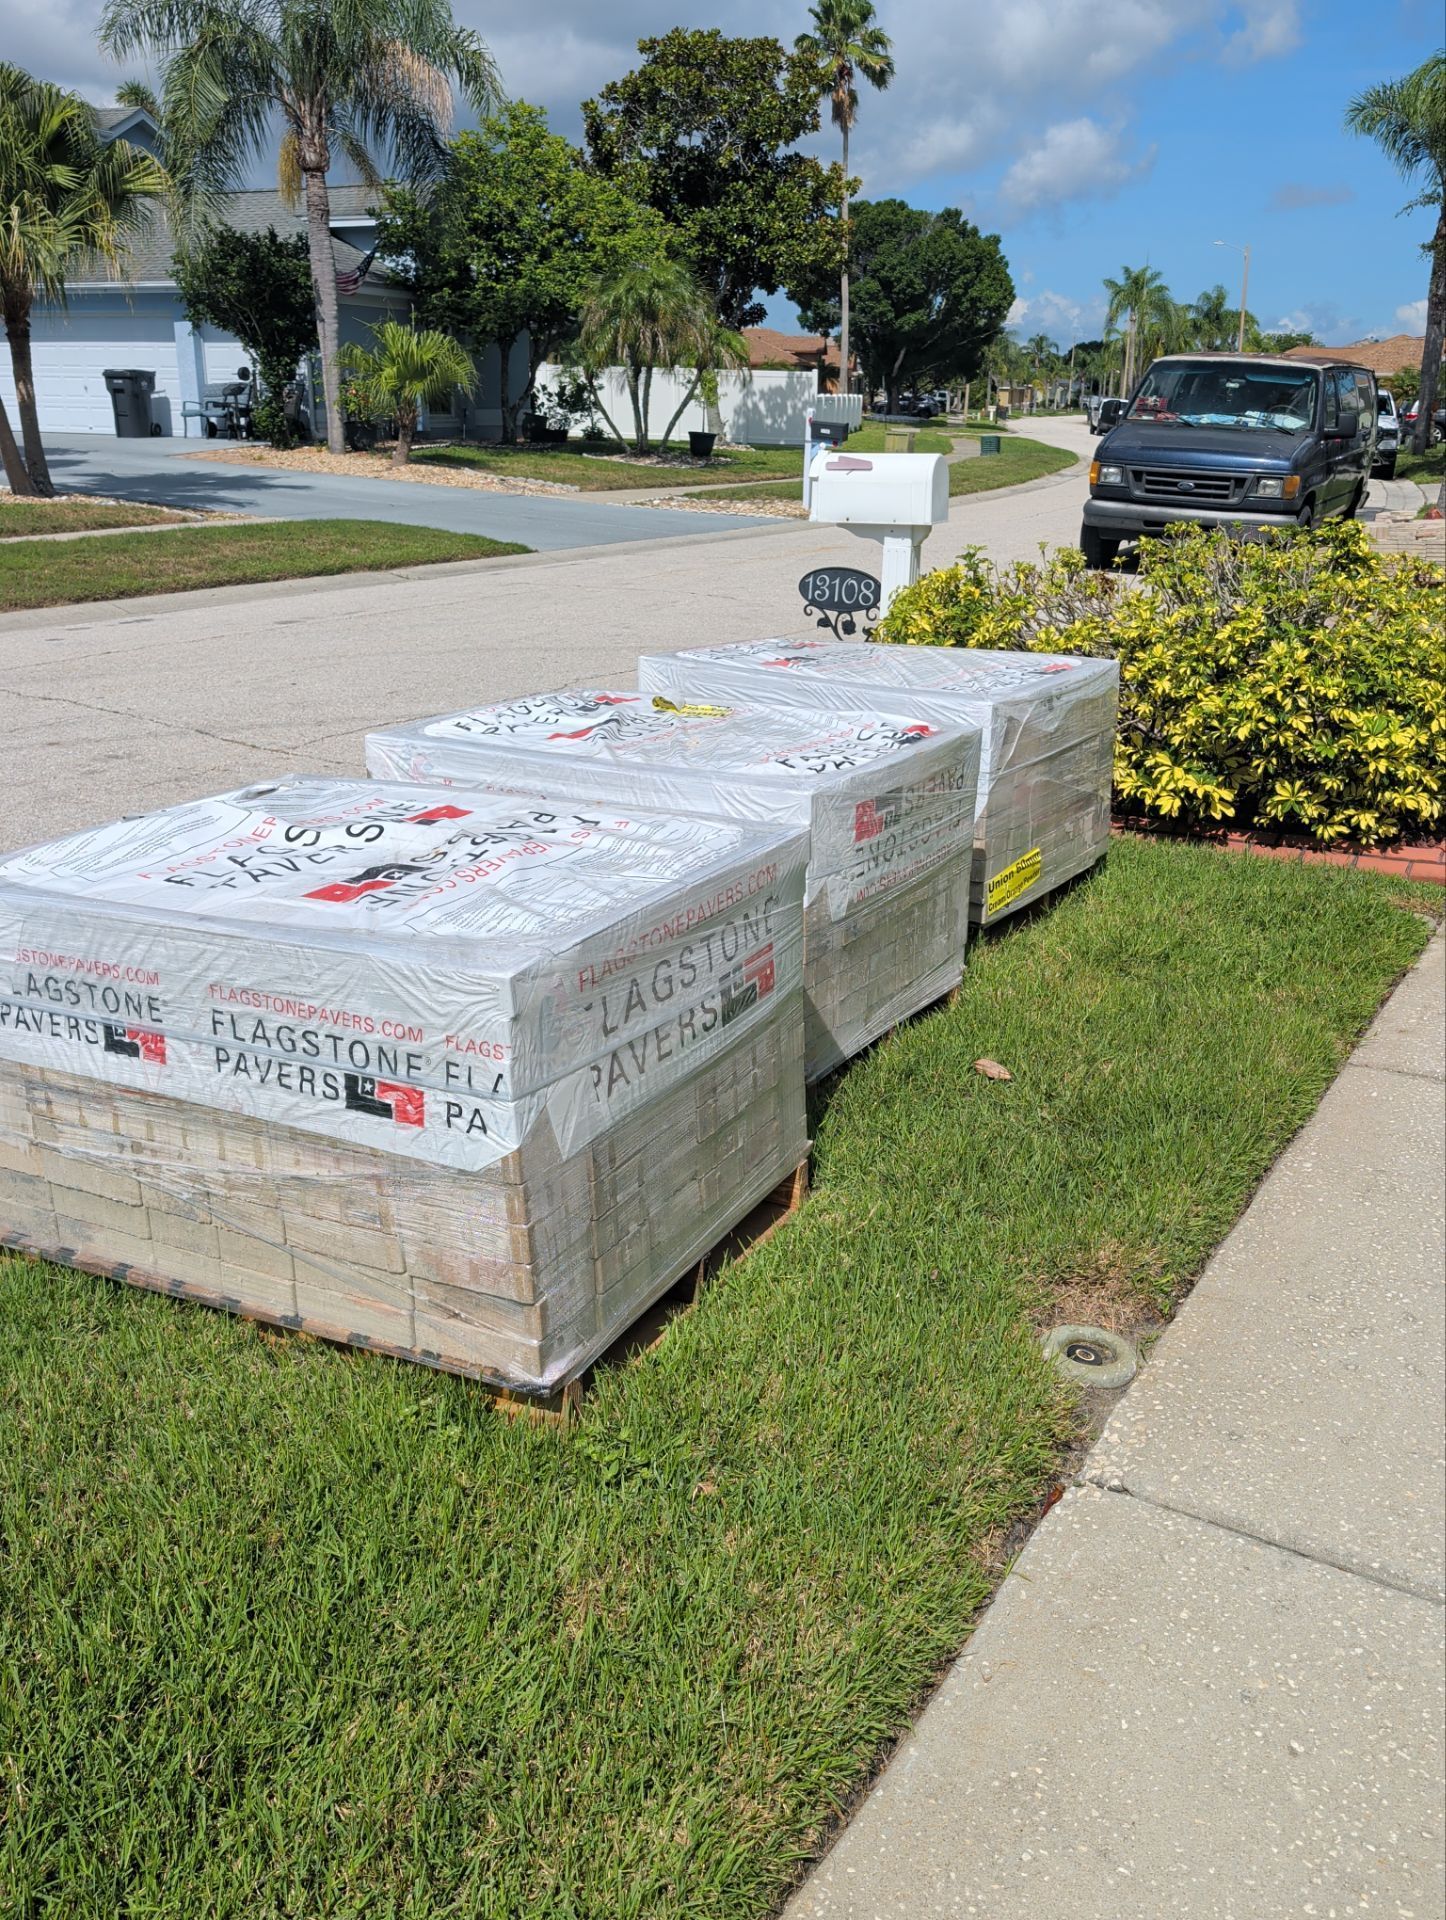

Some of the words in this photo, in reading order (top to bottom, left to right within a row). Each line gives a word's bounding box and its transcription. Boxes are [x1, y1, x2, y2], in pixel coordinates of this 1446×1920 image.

[804, 574, 876, 606] 13108
[137, 798, 390, 879] FAGSTONEPERS.COM
[163, 803, 428, 887] FLAGSNE
[988, 871, 1014, 894] Union
[579, 863, 778, 993] FLAGSTONEPAVERS.COM
[584, 895, 777, 1038] LAGSTONE
[0, 1003, 99, 1045] PAVERS
[12, 972, 163, 1023] LAGSTONE
[209, 984, 424, 1043] FLAGSTONEPAVERS.COM
[215, 1047, 341, 1101] PAVERS
[590, 995, 719, 1102] PAVERS
